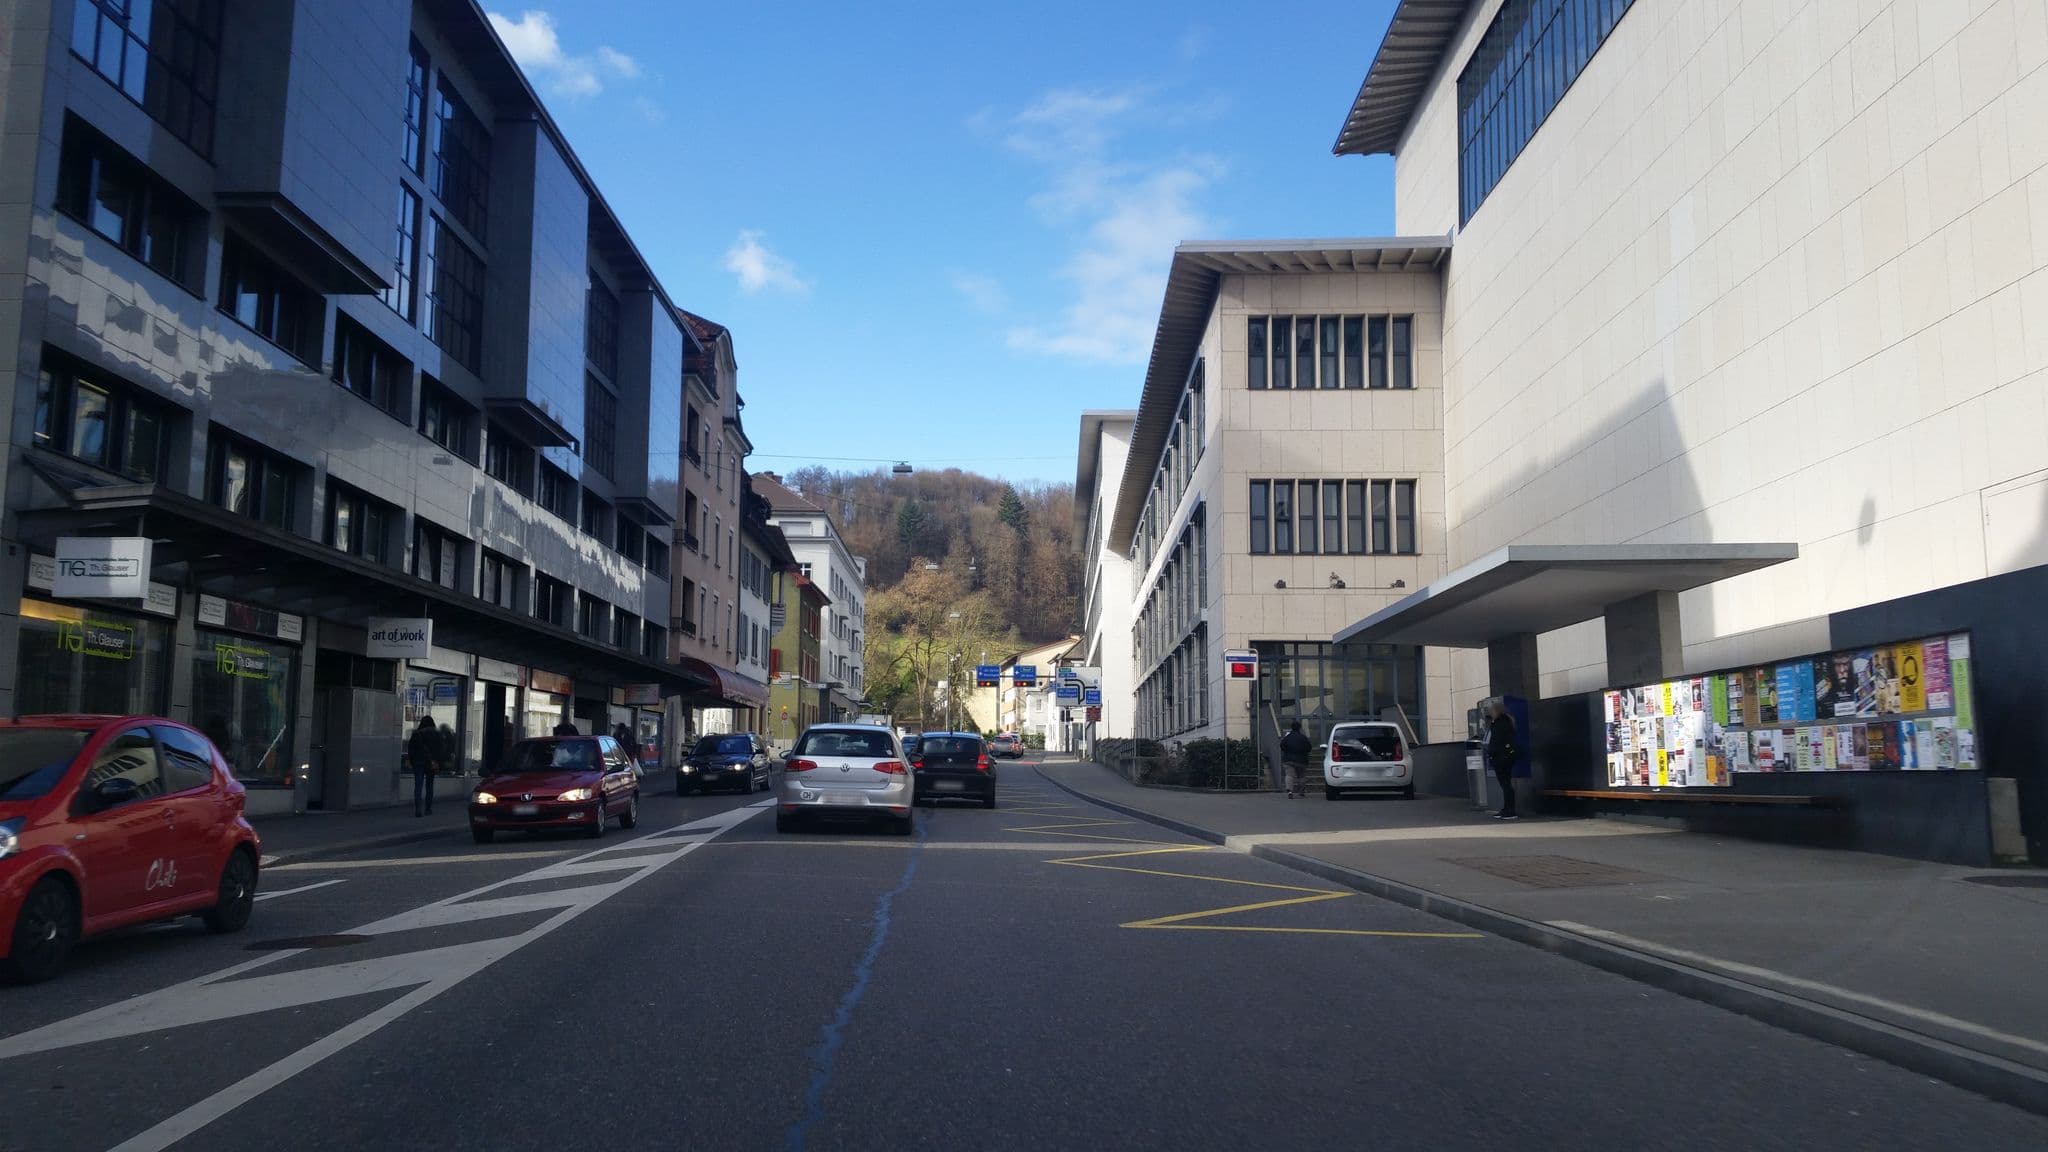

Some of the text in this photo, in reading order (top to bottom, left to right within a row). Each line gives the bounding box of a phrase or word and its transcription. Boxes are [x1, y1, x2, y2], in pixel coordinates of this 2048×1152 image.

[372, 628, 425, 642] art of work
